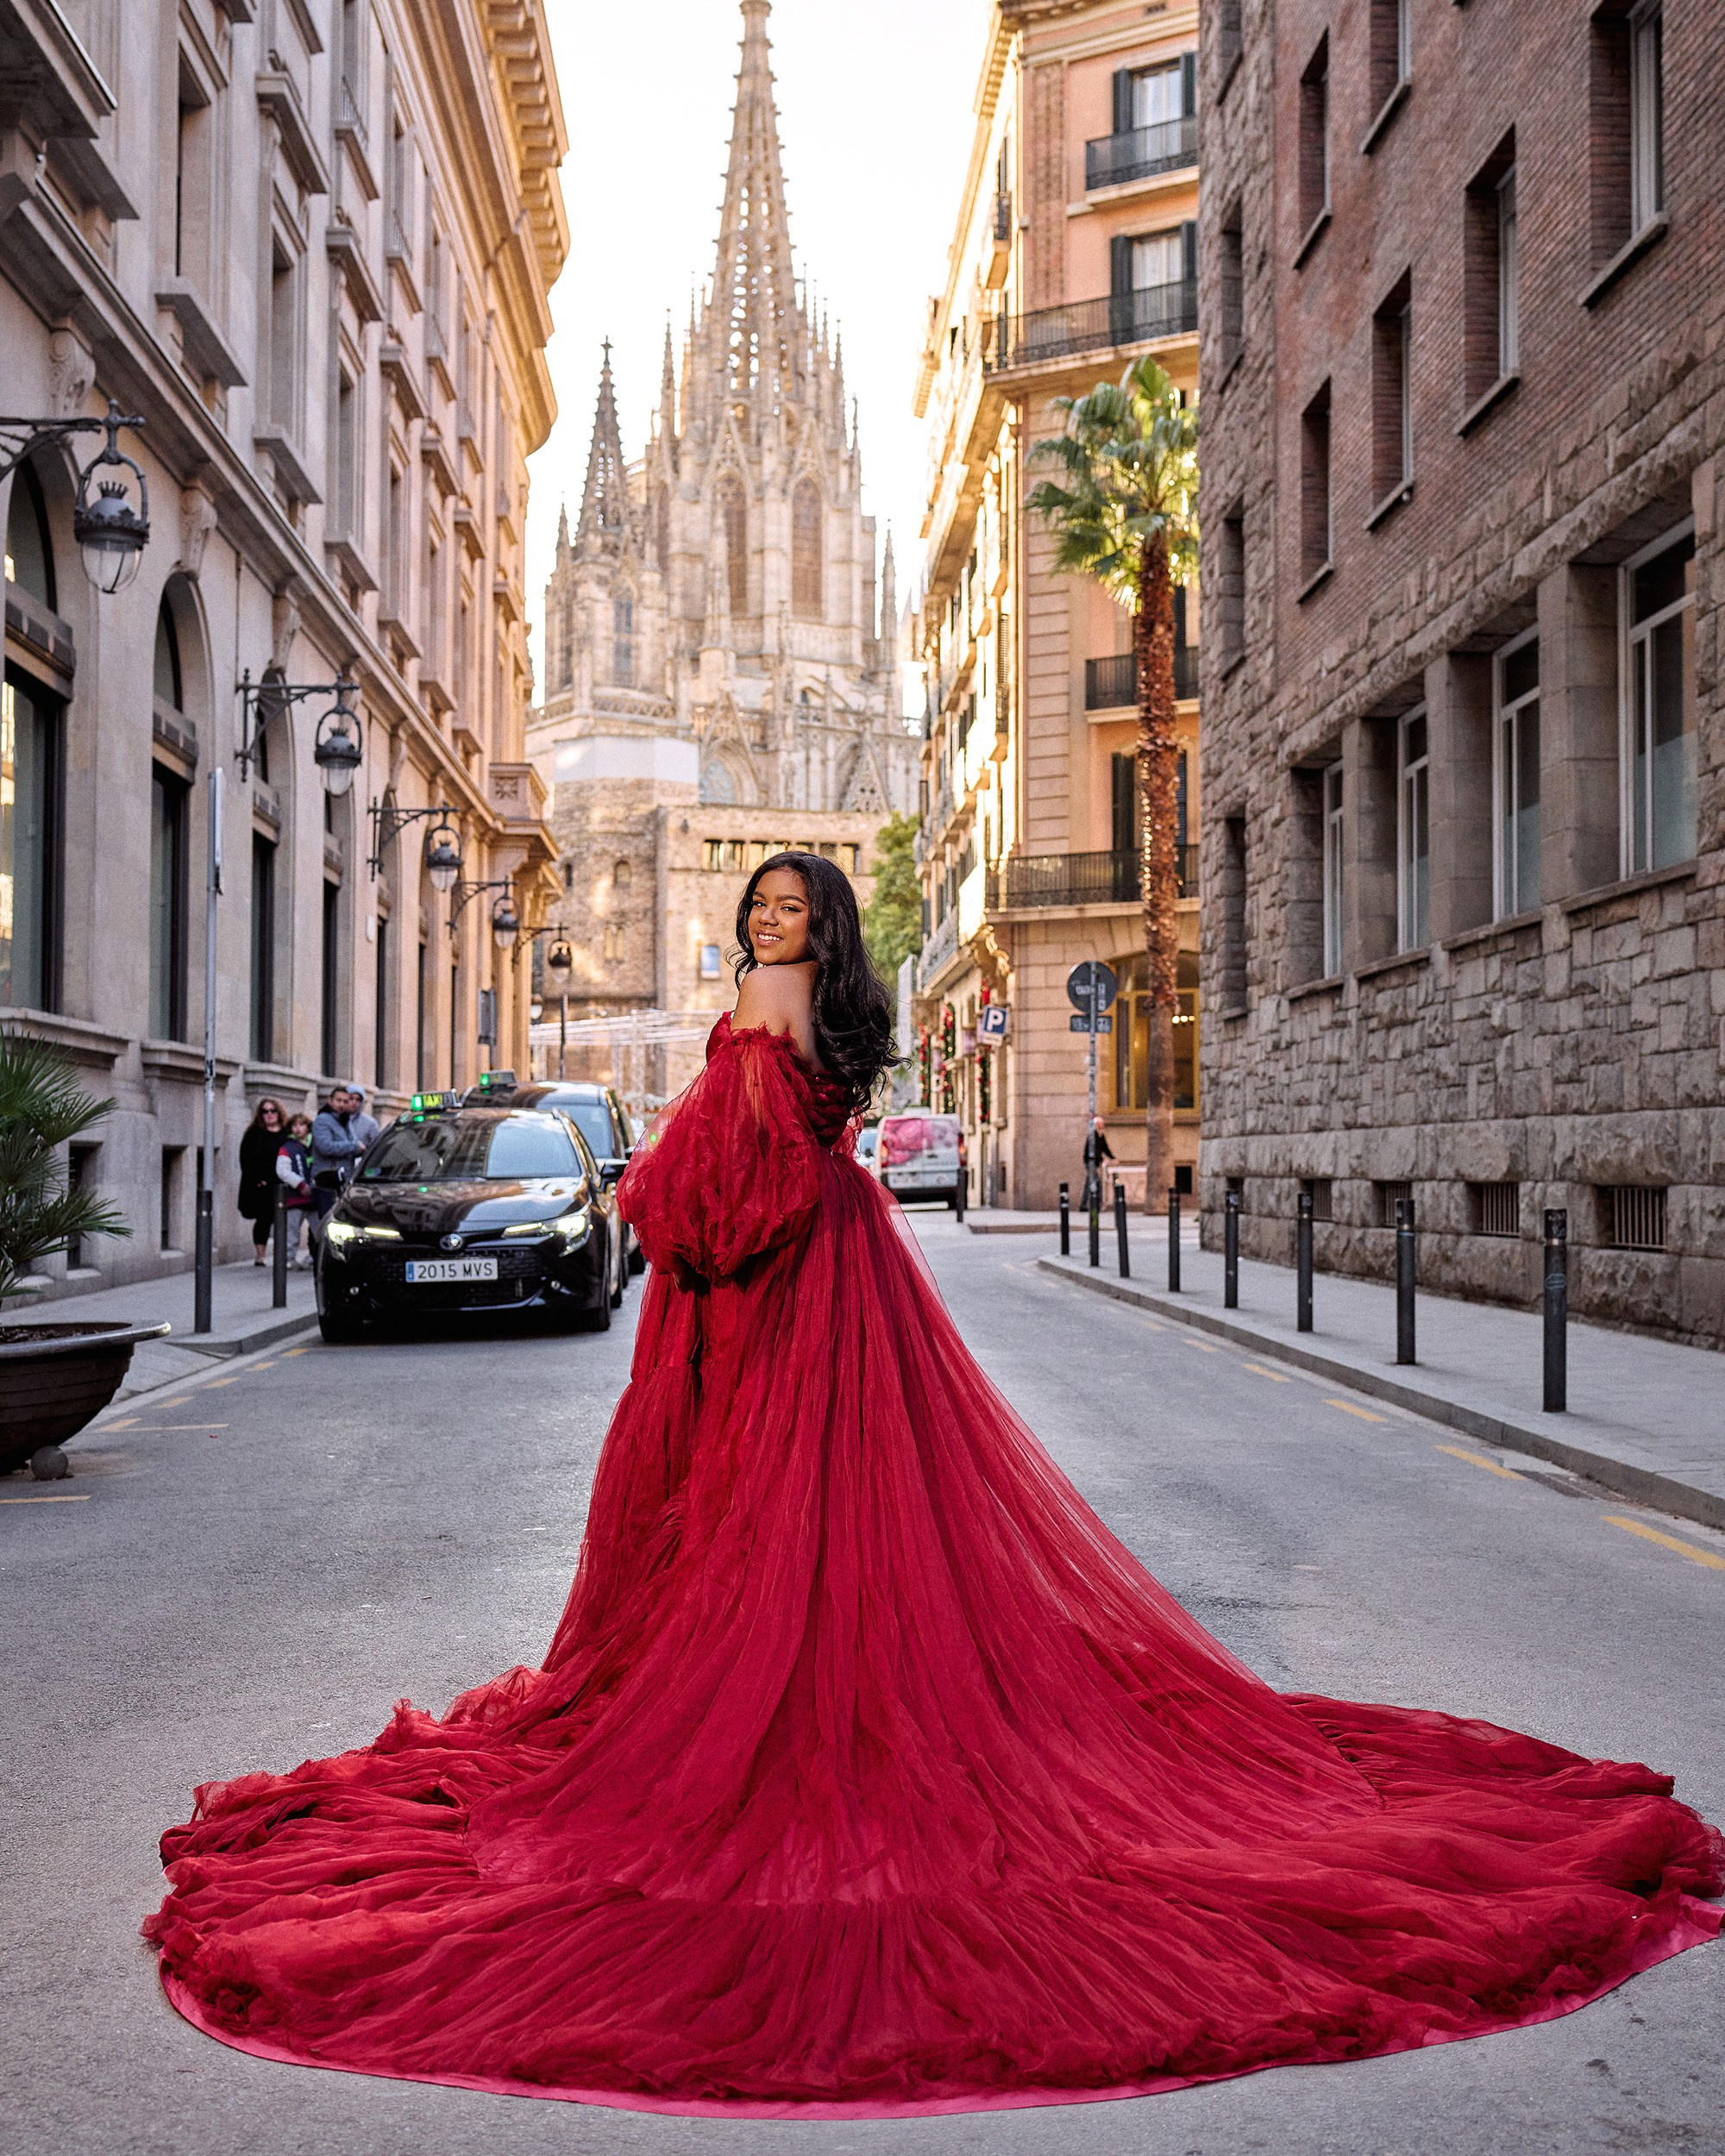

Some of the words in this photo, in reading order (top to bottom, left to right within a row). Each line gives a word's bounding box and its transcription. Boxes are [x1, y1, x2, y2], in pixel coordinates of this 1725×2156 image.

[987, 1009, 1004, 1031] P
[418, 1263, 457, 1279] 2015
[462, 1263, 492, 1277] MVS
